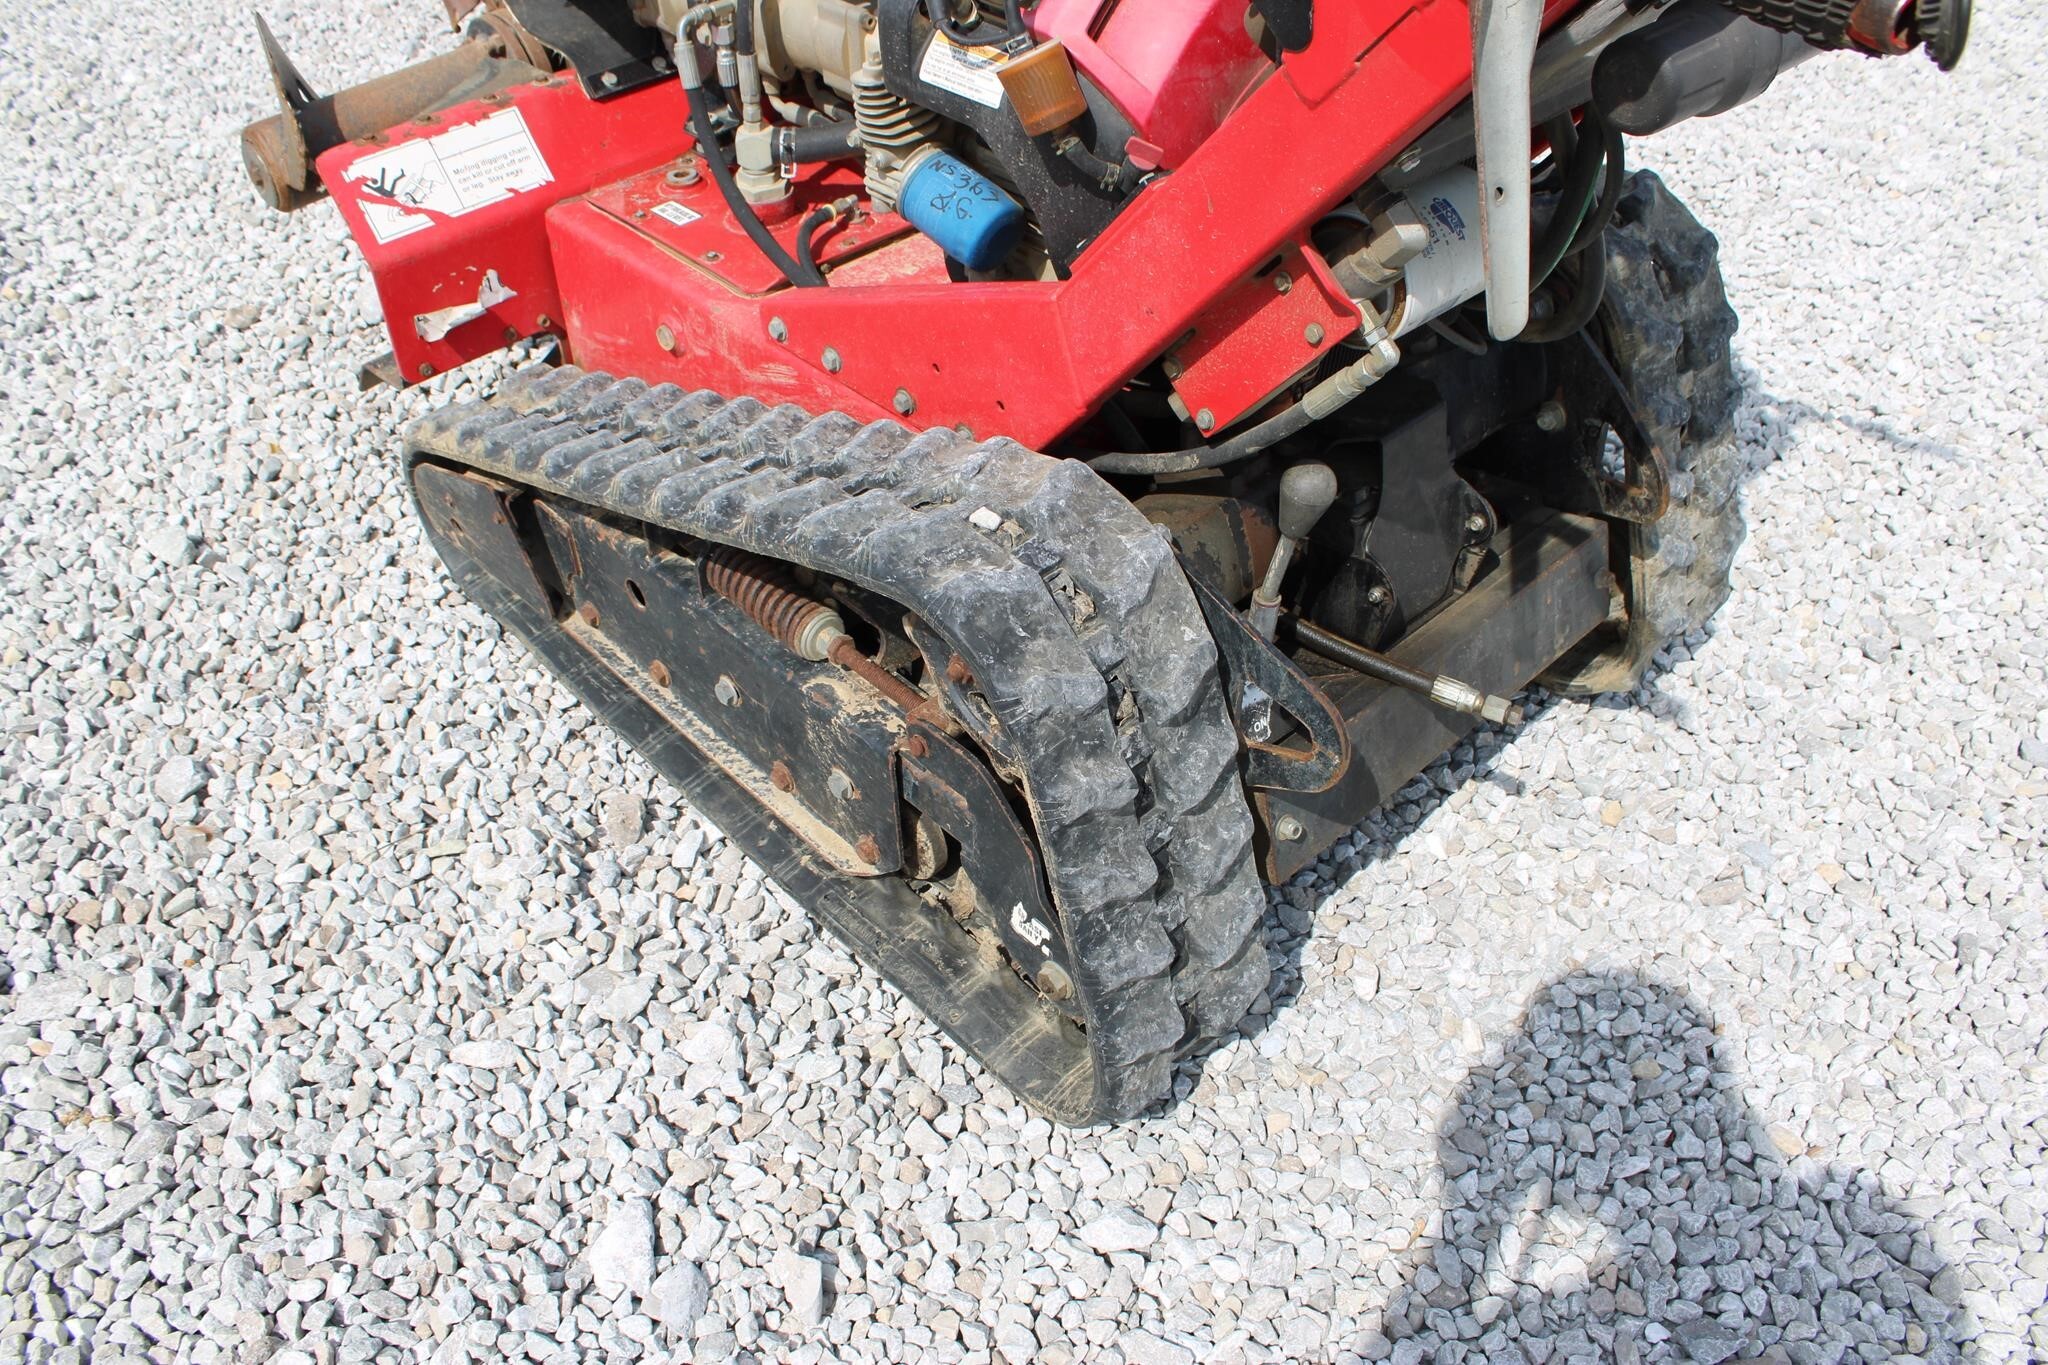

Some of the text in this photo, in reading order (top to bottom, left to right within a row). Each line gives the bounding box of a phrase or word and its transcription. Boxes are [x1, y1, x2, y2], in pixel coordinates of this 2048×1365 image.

[481, 154, 508, 166] digging
[508, 146, 527, 157] chain
[458, 176, 471, 185] can
[472, 170, 484, 179] kill
[494, 163, 506, 172] cut
[507, 158, 516, 167] off
[518, 155, 531, 163] arm
[487, 175, 504, 184] Stay
